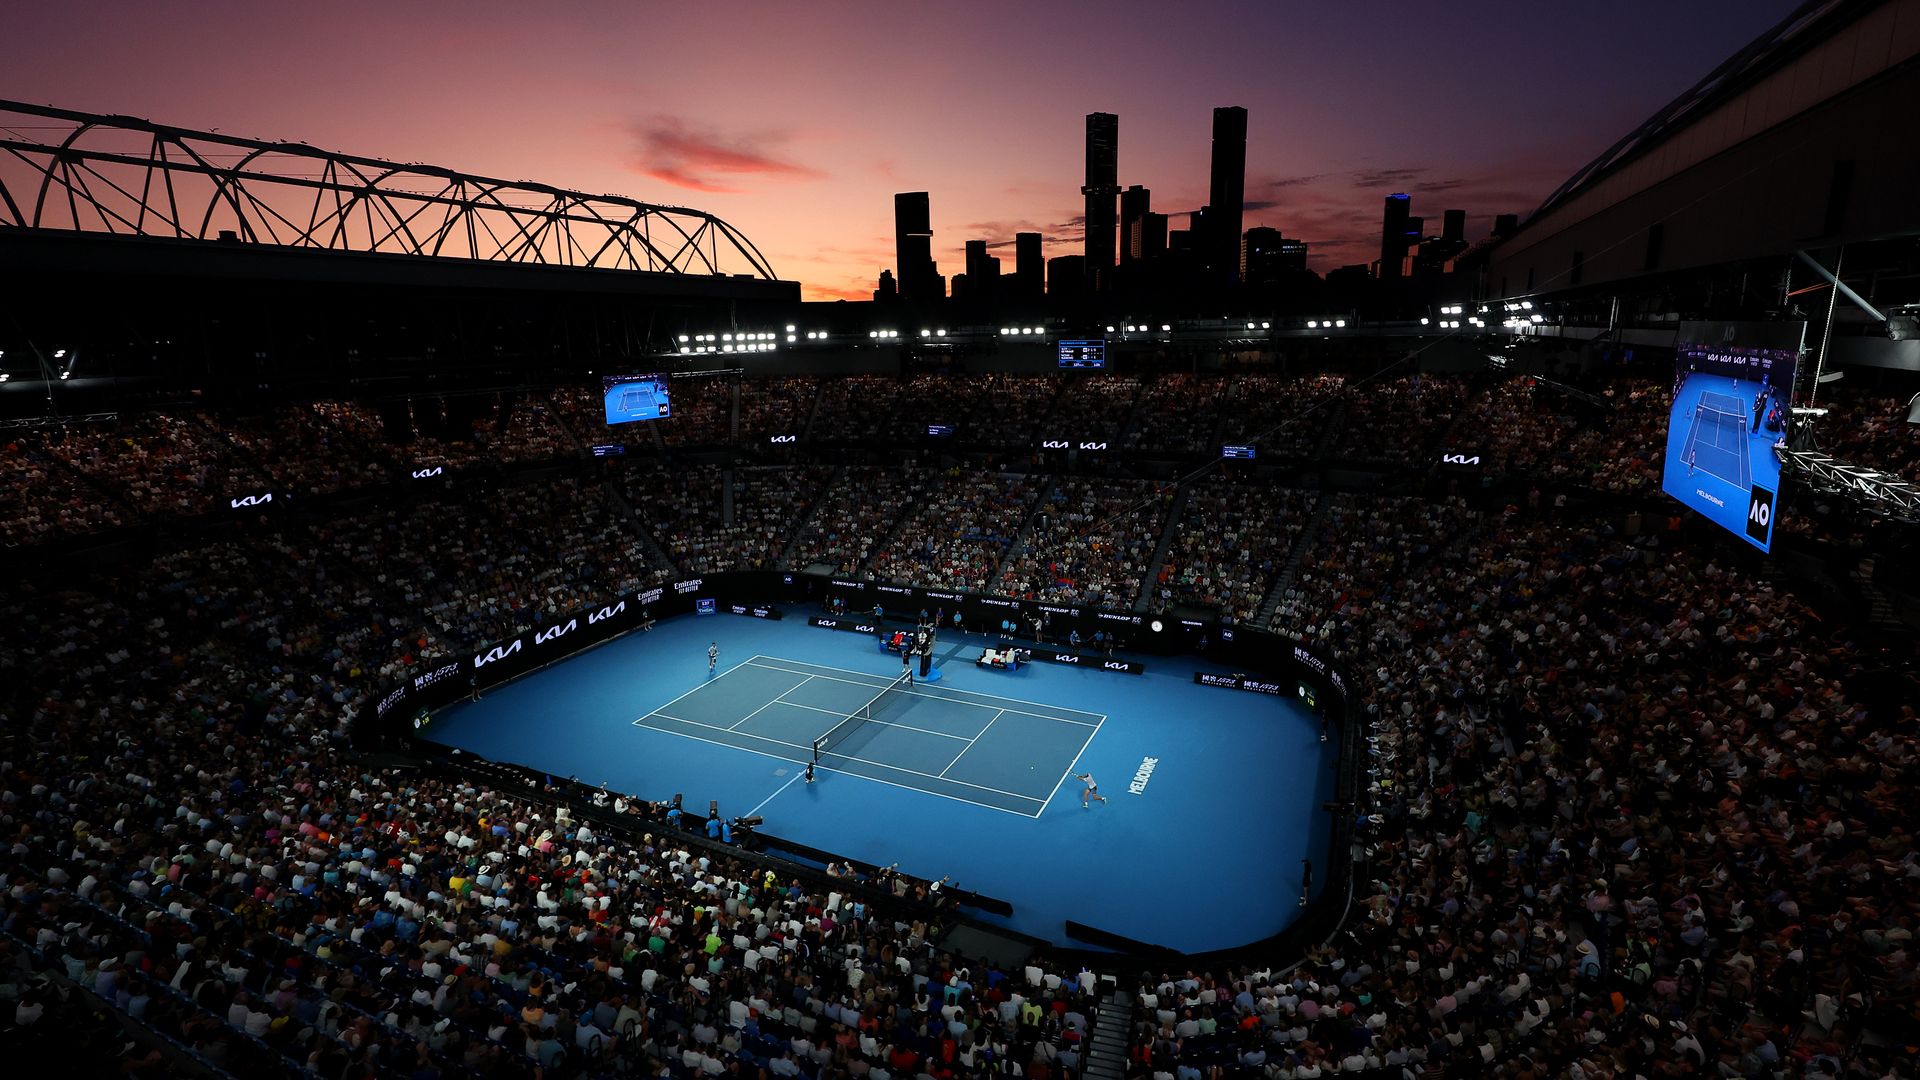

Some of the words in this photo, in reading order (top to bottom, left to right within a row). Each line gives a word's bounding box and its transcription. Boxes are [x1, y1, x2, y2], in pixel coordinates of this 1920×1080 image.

[1443, 454, 1480, 465] KIA
[412, 466, 442, 479] KIA
[231, 493, 273, 509] KIA
[1749, 499, 1770, 527] AO
[673, 579, 703, 590] Emirates
[637, 587, 664, 601] Emirates
[588, 600, 625, 626] KIA
[535, 618, 577, 646] KIA
[475, 639, 522, 669] KIA
[1055, 654, 1080, 663] KIA
[1104, 661, 1129, 671] KIA
[1127, 756, 1159, 796] MELBOURNE
